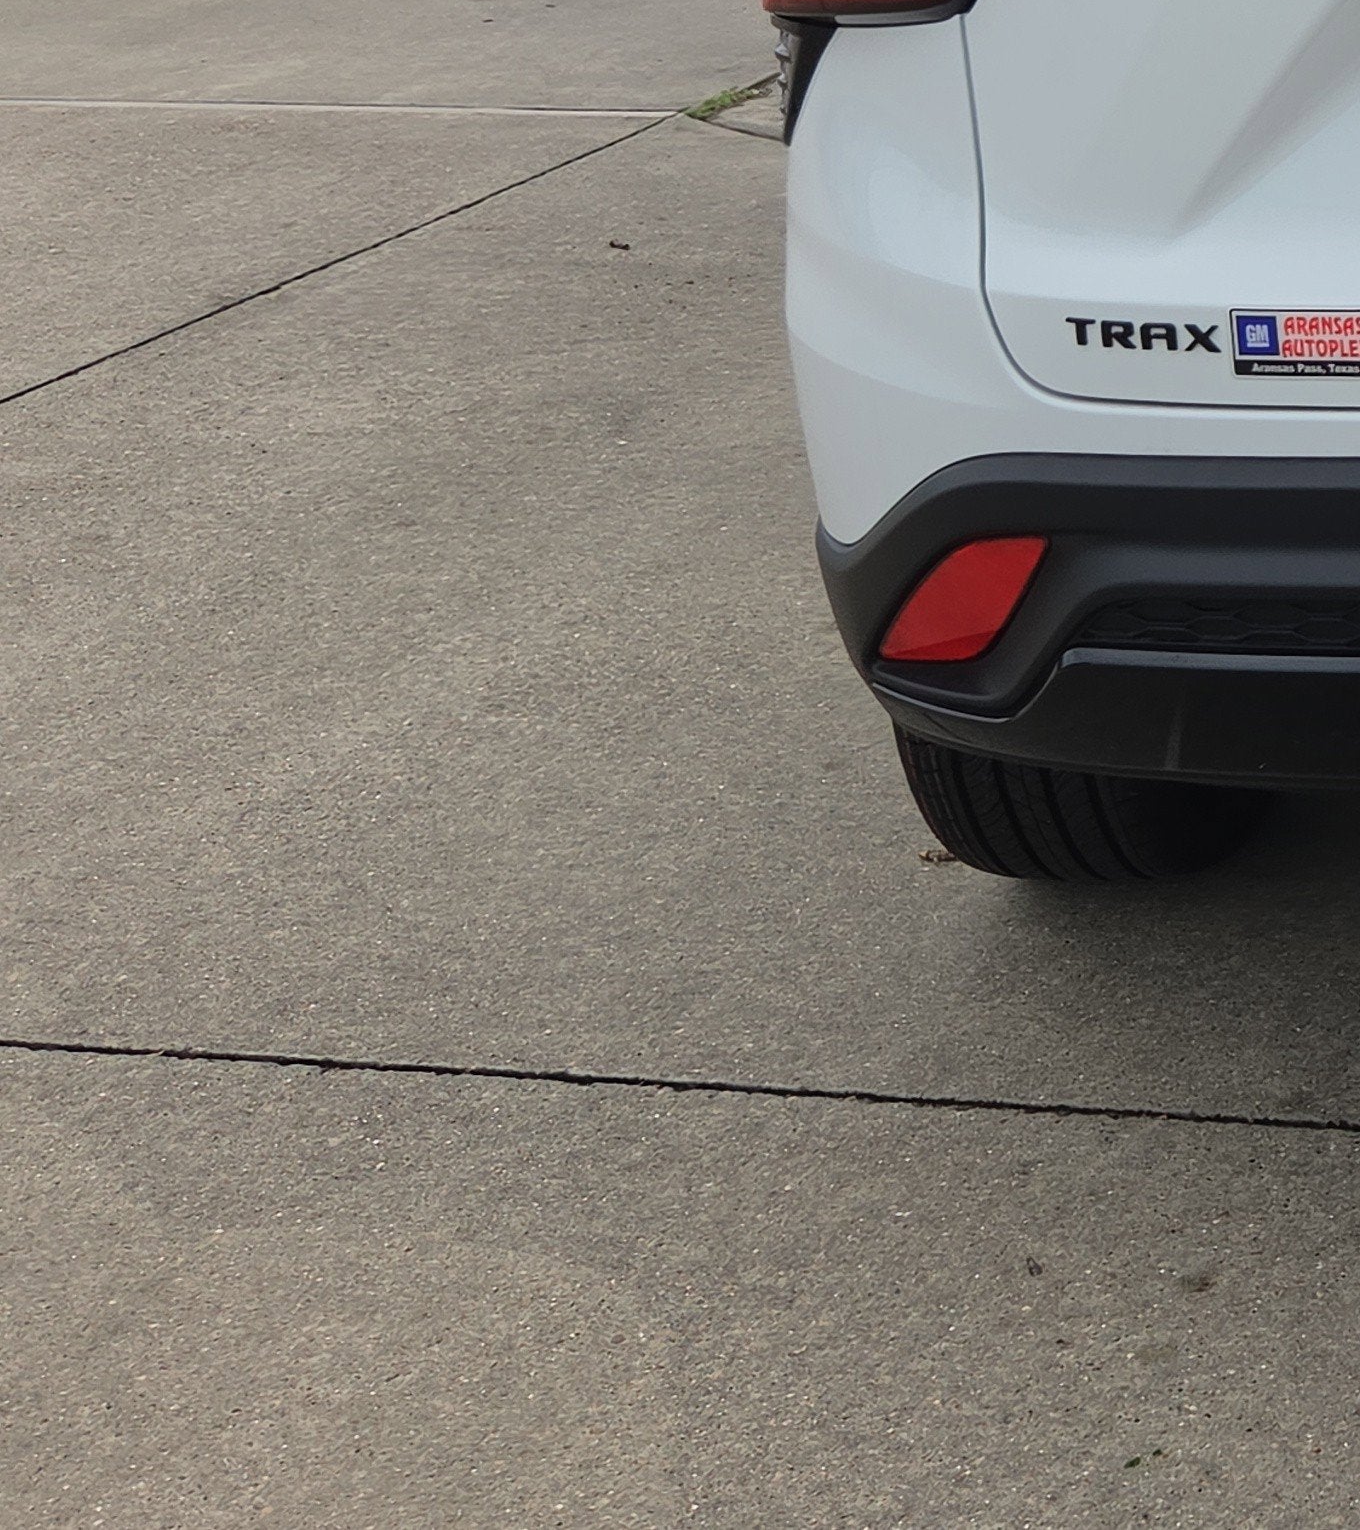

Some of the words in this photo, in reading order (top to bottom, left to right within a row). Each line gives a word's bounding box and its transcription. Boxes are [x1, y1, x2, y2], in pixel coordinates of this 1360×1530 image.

[1065, 316, 1222, 354] TRAX
[1245, 323, 1270, 348] GM
[1327, 362, 1360, 374] Texas
